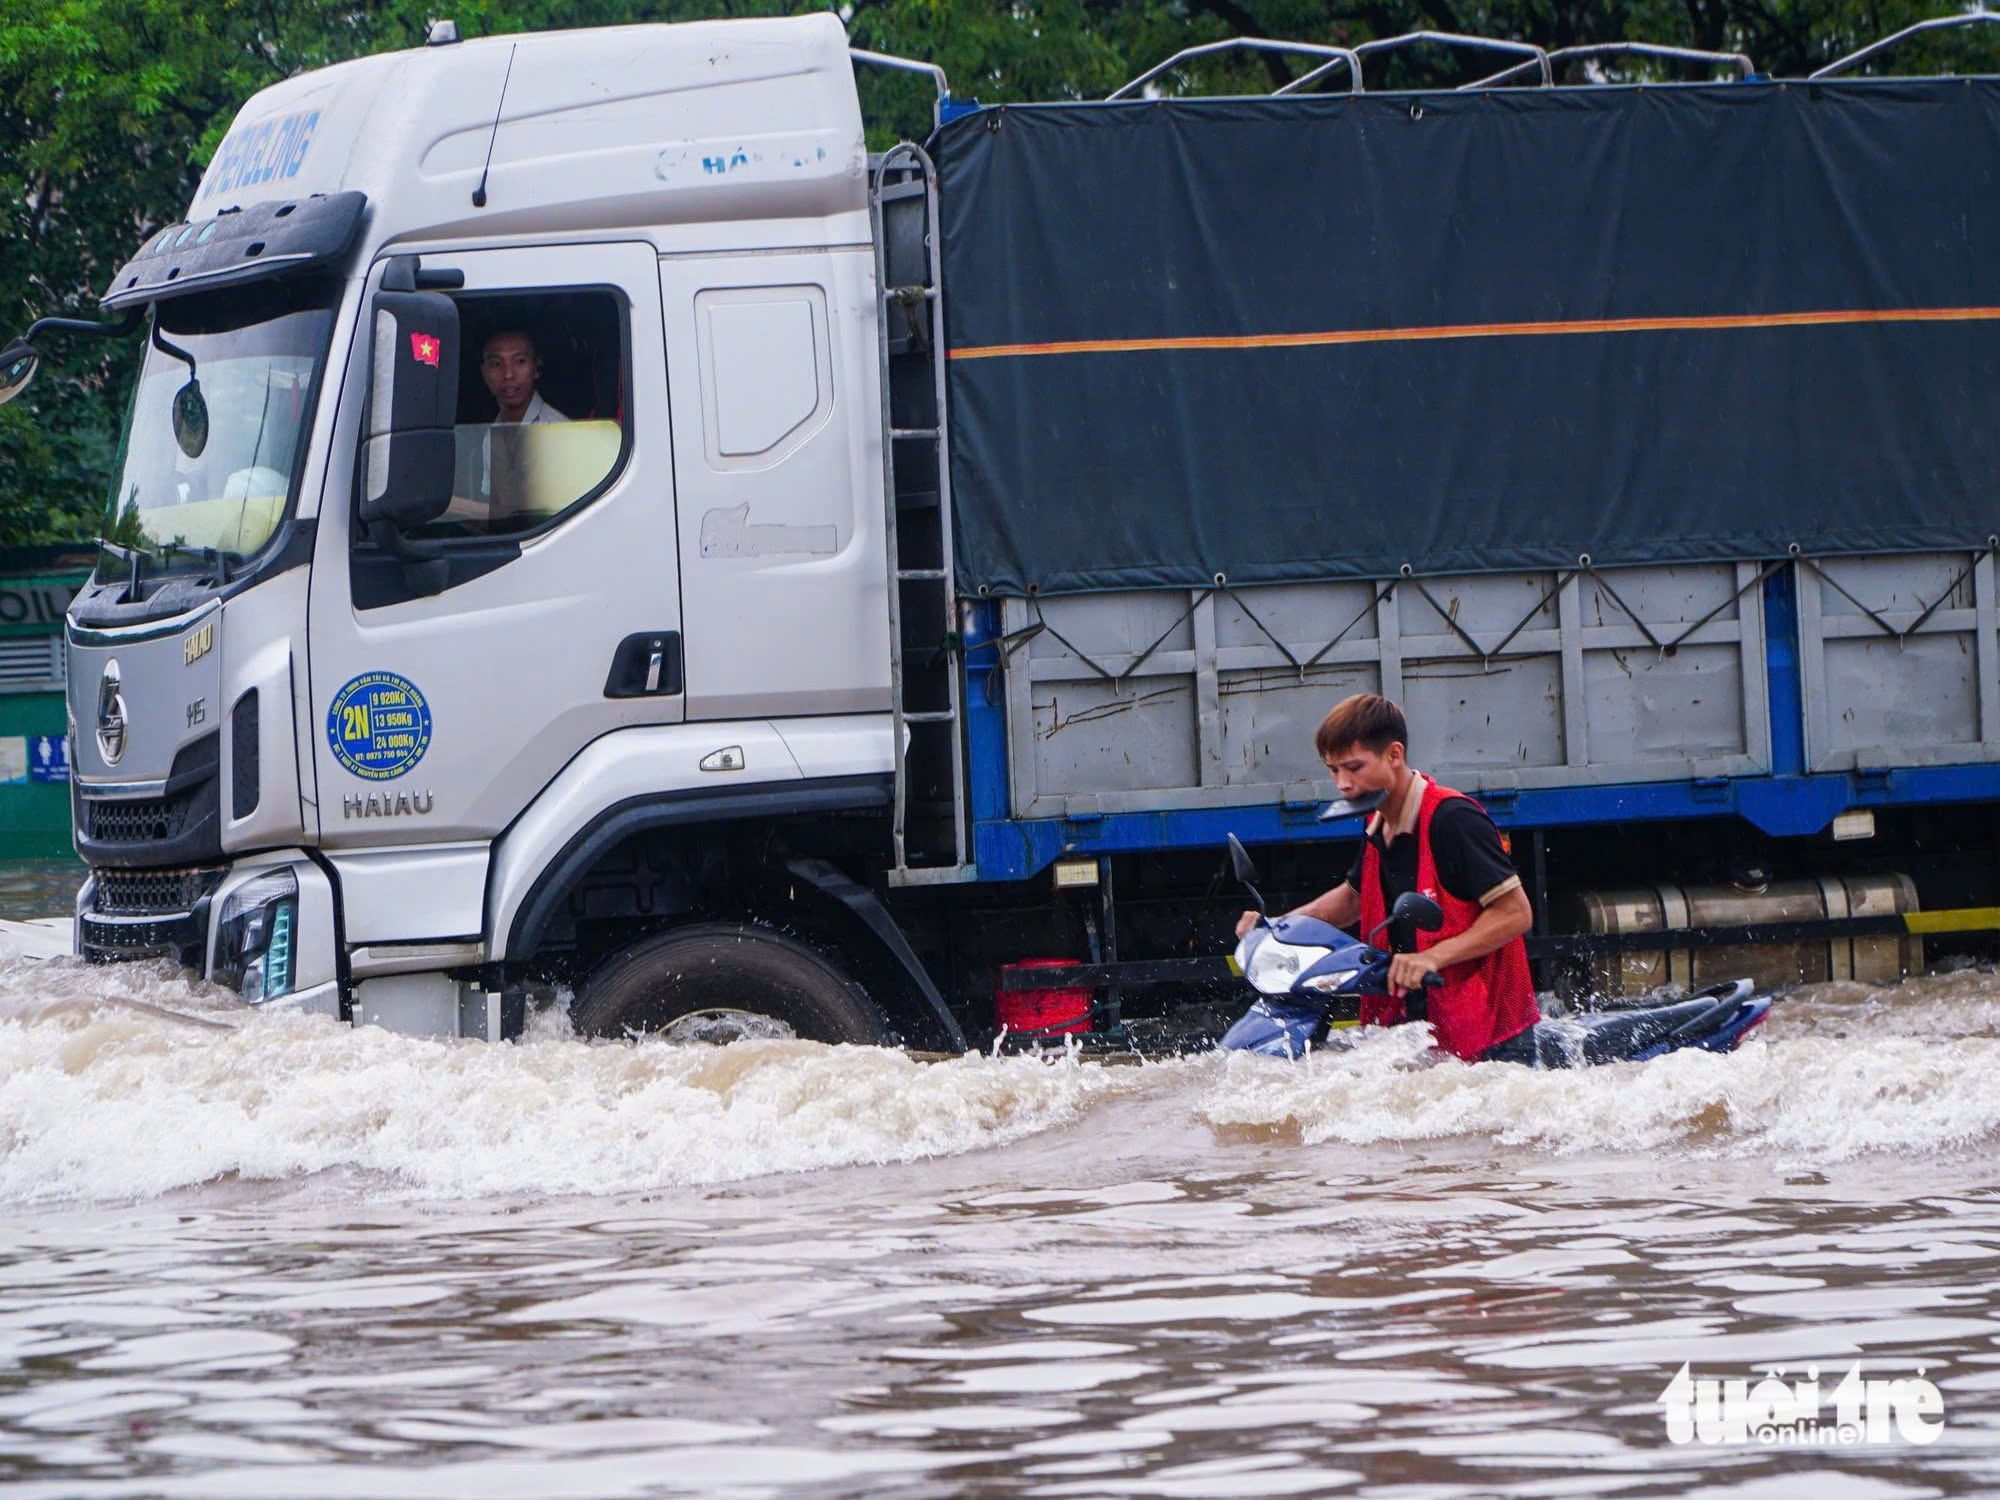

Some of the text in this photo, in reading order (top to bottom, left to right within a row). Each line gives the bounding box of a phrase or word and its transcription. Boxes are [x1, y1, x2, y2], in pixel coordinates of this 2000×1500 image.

[0, 587, 76, 623] OIL
[183, 623, 213, 667] HAIAU
[373, 692, 406, 707] 9 920Kg
[343, 705, 370, 741] 2N
[375, 712, 413, 728] 13 950Kg
[376, 734, 414, 750] 24 000Kg
[344, 787, 433, 819] HAIAU
